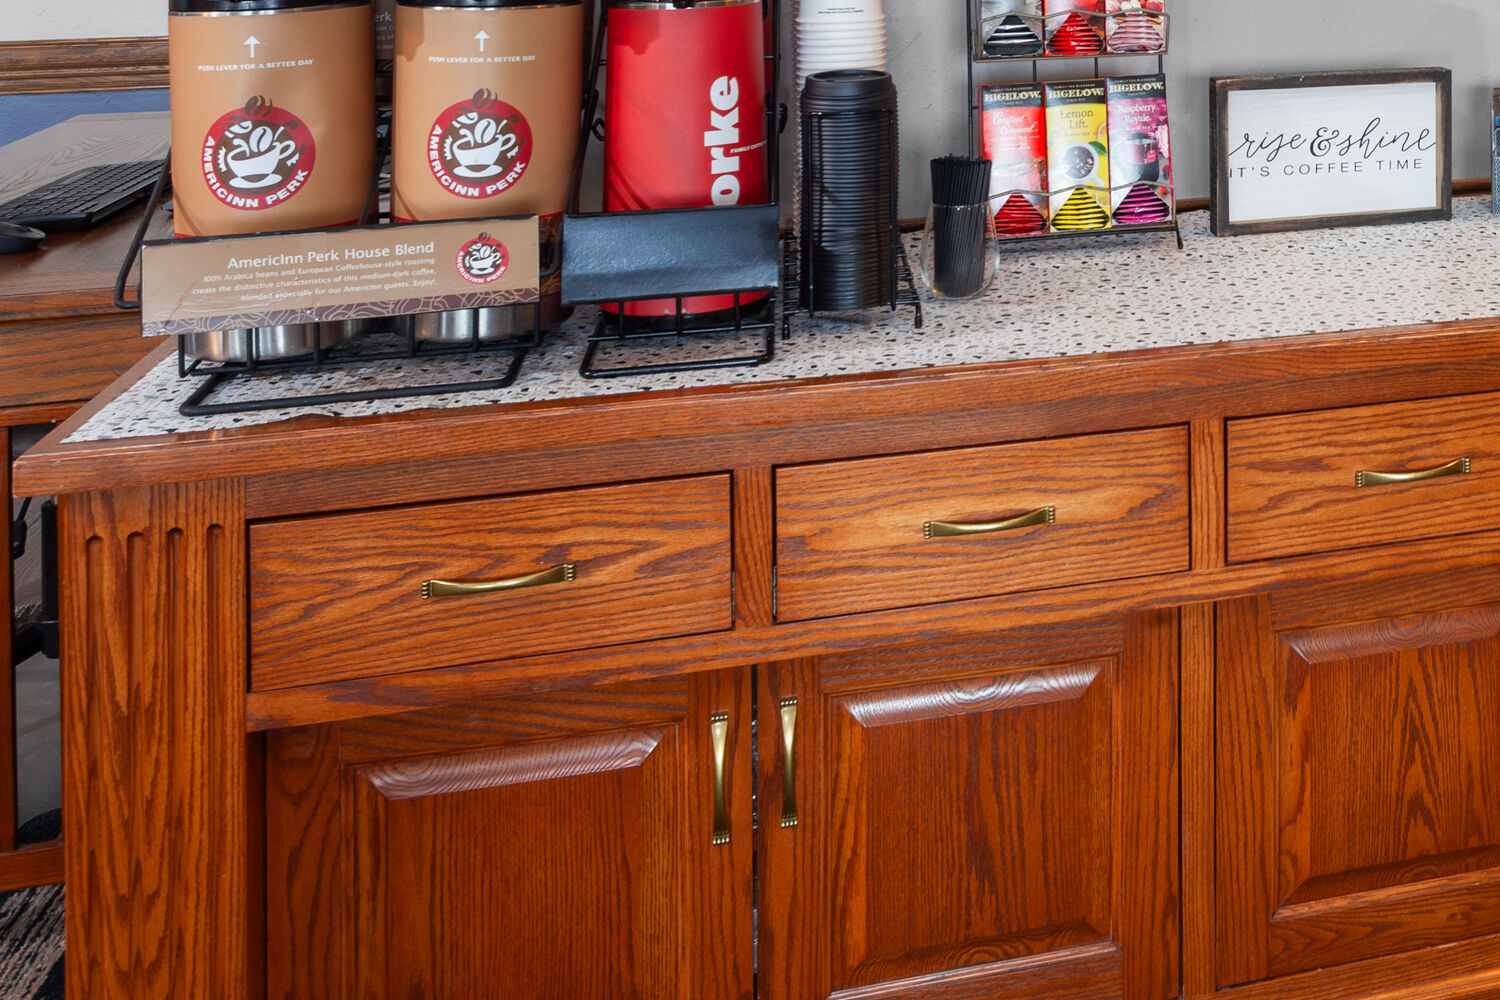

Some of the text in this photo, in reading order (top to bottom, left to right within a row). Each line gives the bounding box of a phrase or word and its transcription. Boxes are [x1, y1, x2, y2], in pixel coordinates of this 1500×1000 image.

[240, 63, 257, 71] FOR
[265, 60, 297, 69] BETTER
[1060, 109, 1094, 119] Lemon
[1118, 103, 1156, 114] Raspberry
[1229, 132, 1307, 162] rise
[1335, 117, 1437, 159] shine
[203, 135, 309, 208] AMERICINN PERK
[429, 124, 526, 197] AMERICINN PERK
[1229, 157, 1423, 179] IT'S COFFEE TIME
[227, 240, 435, 270] AmericInn Perk House Blend
[224, 272, 254, 281] Arabica
[255, 270, 279, 278] beans
[281, 268, 296, 276] and
[298, 265, 334, 276] European
[336, 260, 402, 272] Coffeehouse-style
[404, 257, 436, 266] roasting
[486, 265, 506, 282] PERK
[192, 267, 437, 295] create the distinctive characteristics of this medium-dark coffee.
[241, 292, 273, 301] blended
[275, 288, 313, 299] especially
[315, 287, 326, 295] for
[344, 283, 382, 293] AmericInn
[412, 278, 436, 288] Enjoy!
